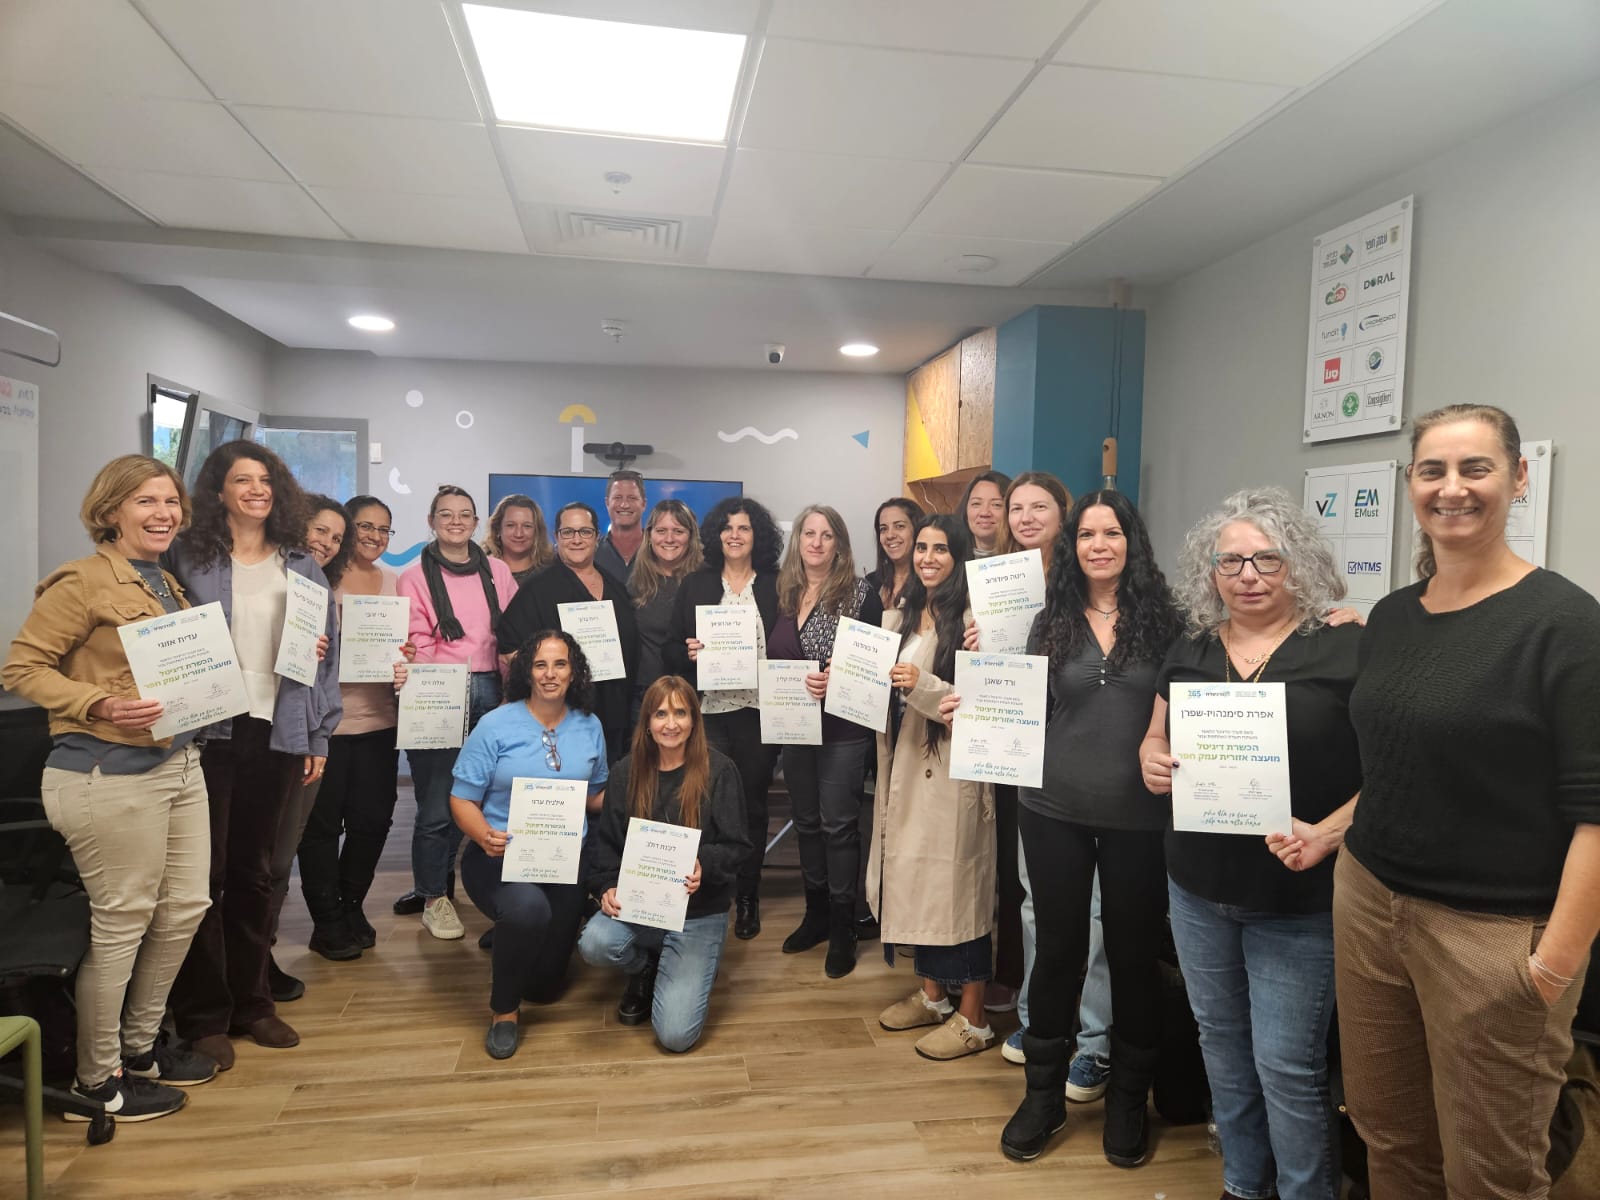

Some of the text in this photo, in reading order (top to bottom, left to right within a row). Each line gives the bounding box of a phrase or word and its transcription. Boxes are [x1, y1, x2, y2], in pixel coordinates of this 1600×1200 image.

[1363, 271, 1396, 290] DORAL
[1354, 488, 1380, 507] EM
[1354, 508, 1379, 518] EMust
[1356, 562, 1382, 572] NTMS
[974, 705, 1024, 716] הכשרת דיגיטל
[1246, 709, 1274, 719] אפרת
[975, 714, 991, 722] עמק
[991, 716, 1015, 724] אזורית
[1016, 719, 1040, 727] מועצה
[1196, 742, 1259, 751] הכשרת דיגיטל
[1198, 753, 1218, 762] עמק
[1220, 753, 1249, 761] אזורית
[1250, 754, 1280, 763] מועצה
